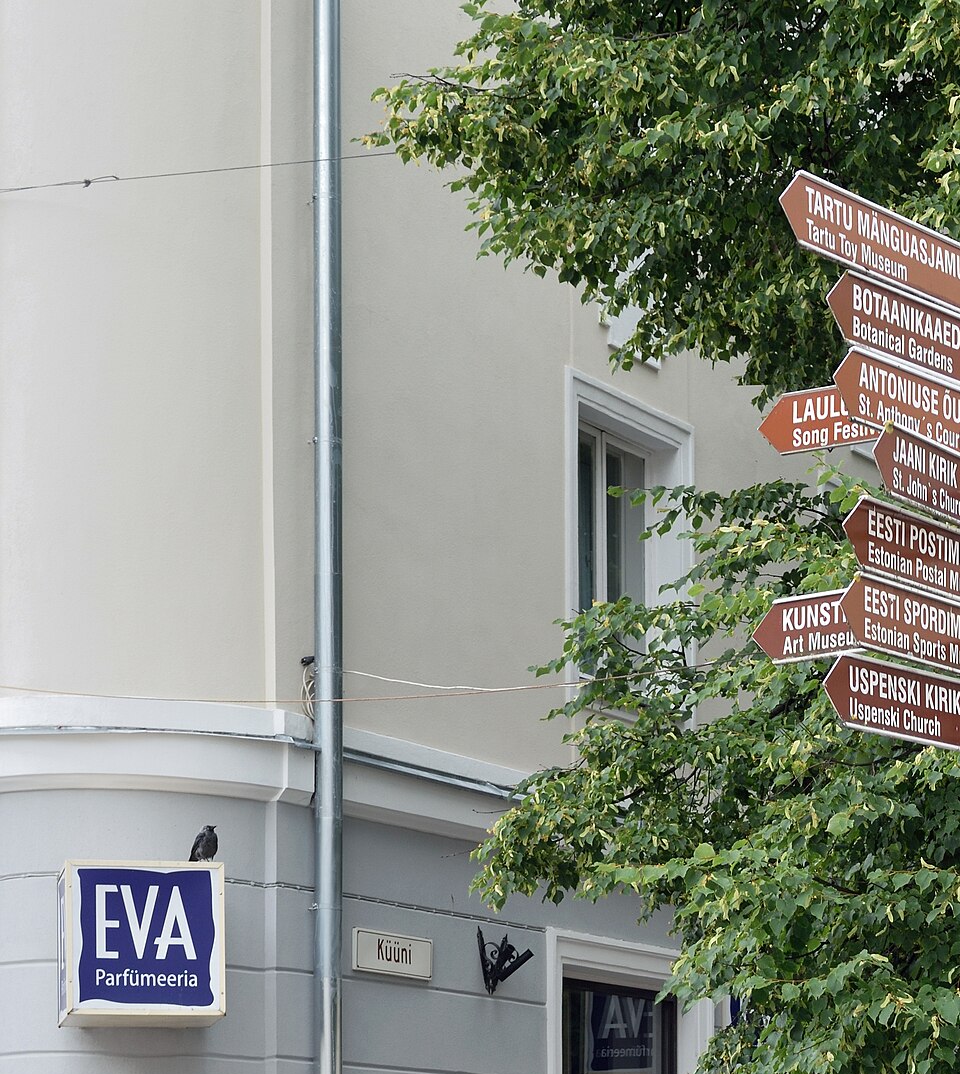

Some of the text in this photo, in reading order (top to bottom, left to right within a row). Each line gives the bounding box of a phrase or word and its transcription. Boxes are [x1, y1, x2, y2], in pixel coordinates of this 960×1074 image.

[805, 186, 853, 230] TARTU
[806, 218, 908, 282] Tartu Toy Museum
[852, 315, 954, 374] Botanical Gardens
[858, 362, 939, 417] ANTONIUSE
[858, 393, 874, 418] St.
[792, 427, 829, 447] Song
[892, 469, 906, 493] St.
[893, 436, 958, 489] JAANI KIRIK
[867, 508, 906, 547] EESTI
[867, 541, 914, 576] Estonian
[915, 555, 948, 588] Postal
[864, 586, 900, 622] EESTI
[783, 634, 804, 655] Art
[864, 617, 911, 650] Estonian
[912, 631, 947, 662] Sports
[849, 664, 921, 707] USPENSKI
[849, 696, 942, 737] Uspenski Church
[95, 884, 198, 960] EVA
[377, 938, 412, 965] Küüni
[95, 968, 198, 987] Parfümeeria
